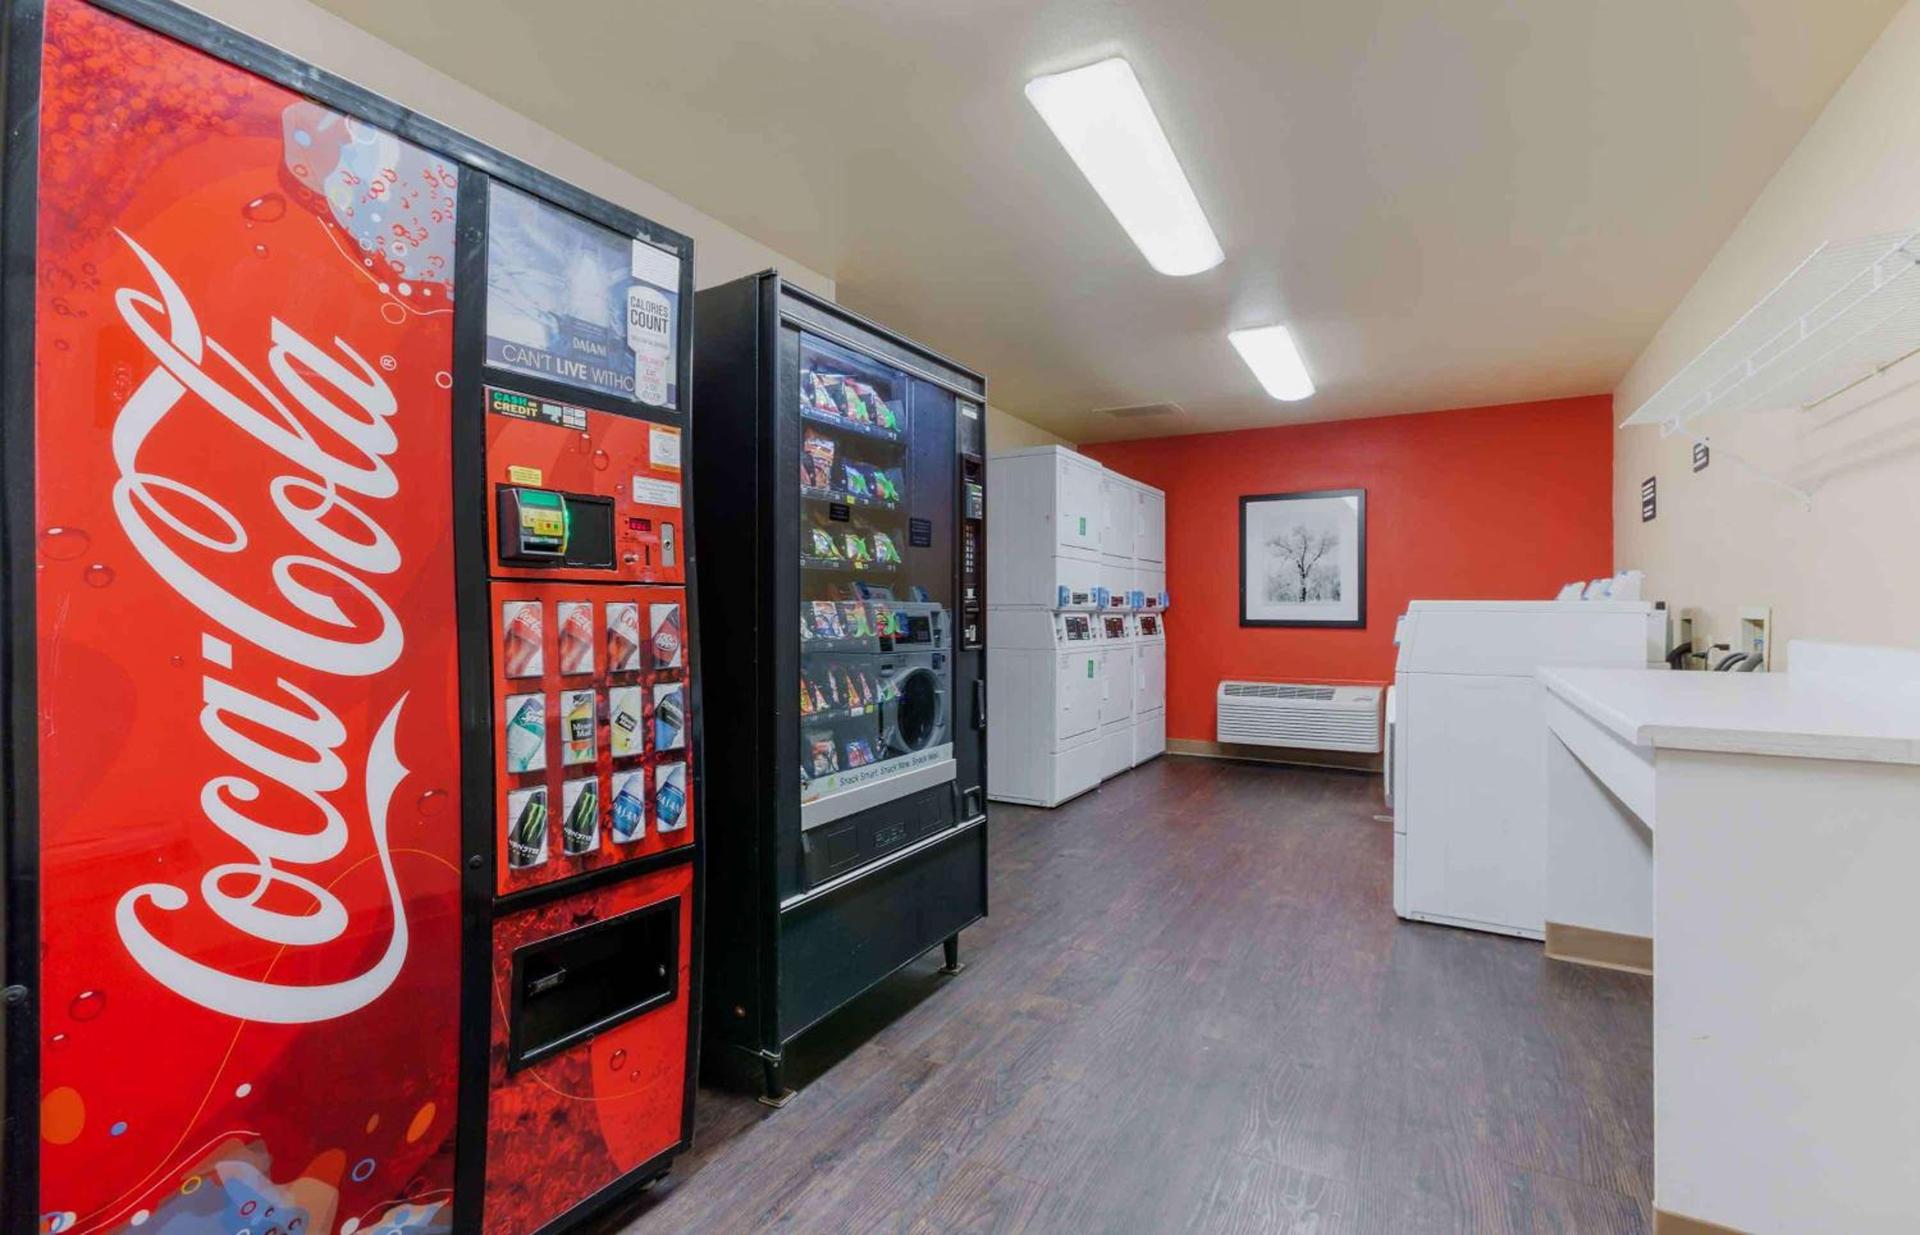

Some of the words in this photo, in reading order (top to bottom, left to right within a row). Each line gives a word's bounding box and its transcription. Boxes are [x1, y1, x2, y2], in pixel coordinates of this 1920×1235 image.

[630, 296, 669, 318] CALORIES
[630, 309, 669, 335] COUNT
[502, 344, 553, 371] CAN'T
[556, 357, 588, 380] LIVE
[493, 401, 538, 417] CREDIT
[112, 226, 410, 1025] Coca-Cola
